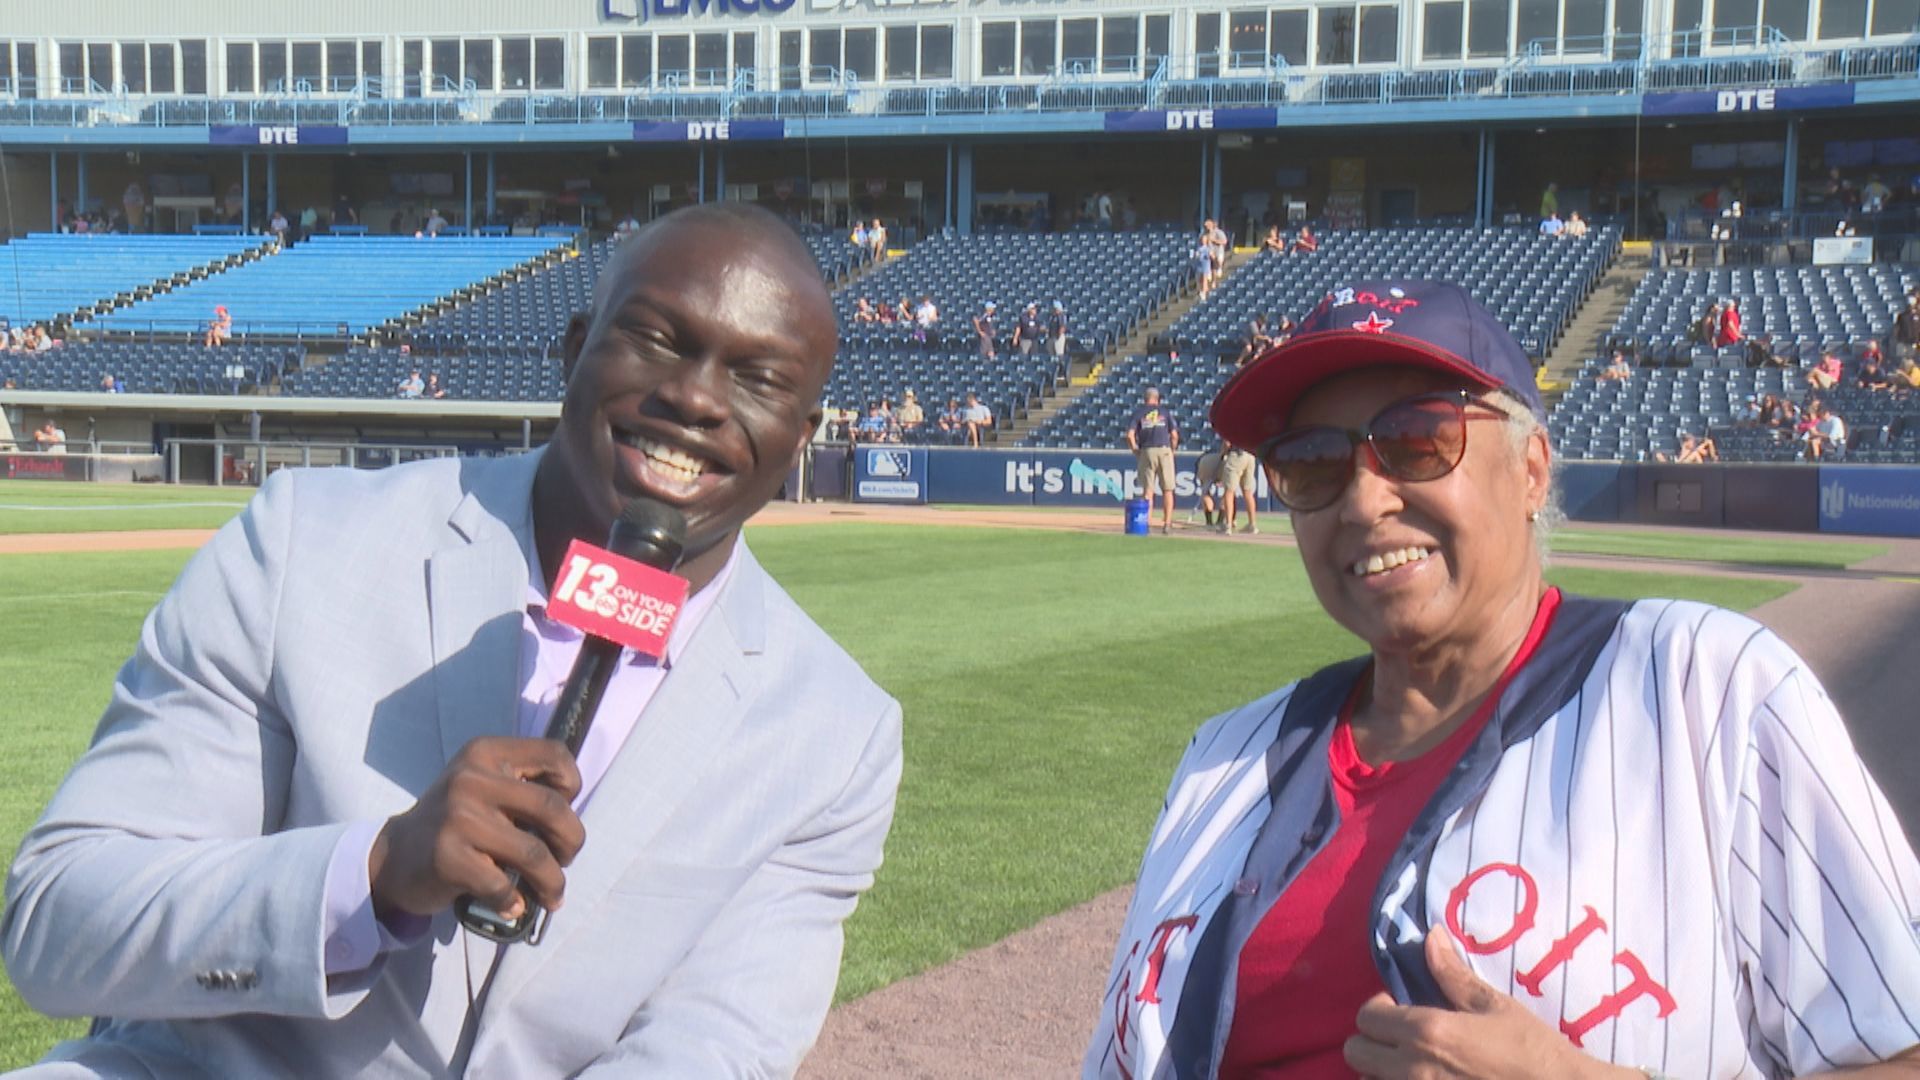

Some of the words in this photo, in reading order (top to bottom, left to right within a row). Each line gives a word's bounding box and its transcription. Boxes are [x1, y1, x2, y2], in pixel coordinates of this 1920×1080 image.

[1717, 89, 1776, 112] DTE
[687, 121, 730, 140] DTE
[1166, 109, 1214, 130] DTE
[259, 126, 298, 145] DTE
[1006, 460, 1064, 493] It's
[1847, 493, 1920, 511] Nationwide
[556, 554, 619, 613] 13
[613, 585, 639, 602] ON
[639, 593, 677, 616] YOUR
[616, 603, 672, 638] SIDE
